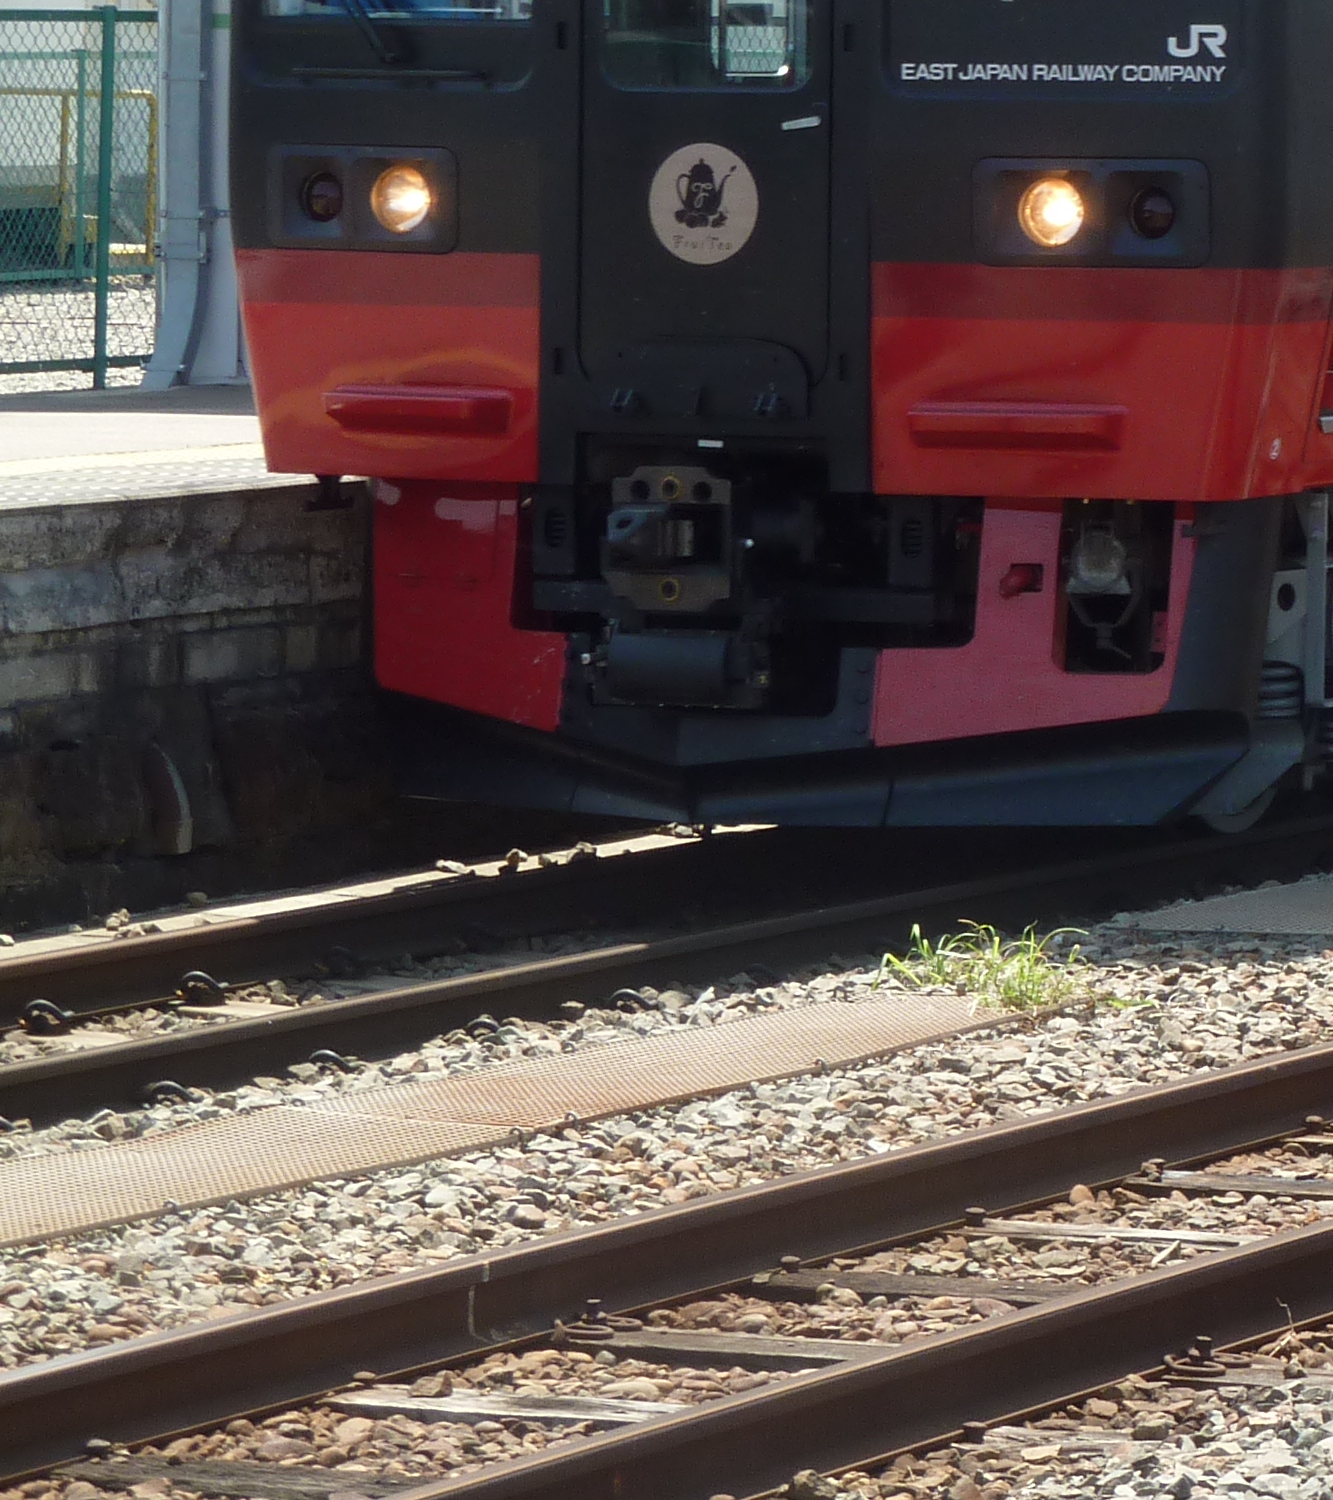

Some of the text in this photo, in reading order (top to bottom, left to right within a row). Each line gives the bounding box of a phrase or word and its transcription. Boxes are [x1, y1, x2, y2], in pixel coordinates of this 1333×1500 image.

[1167, 23, 1228, 58] JR
[901, 62, 1227, 83] EAST JAPAN RAILWAY COMPANY
